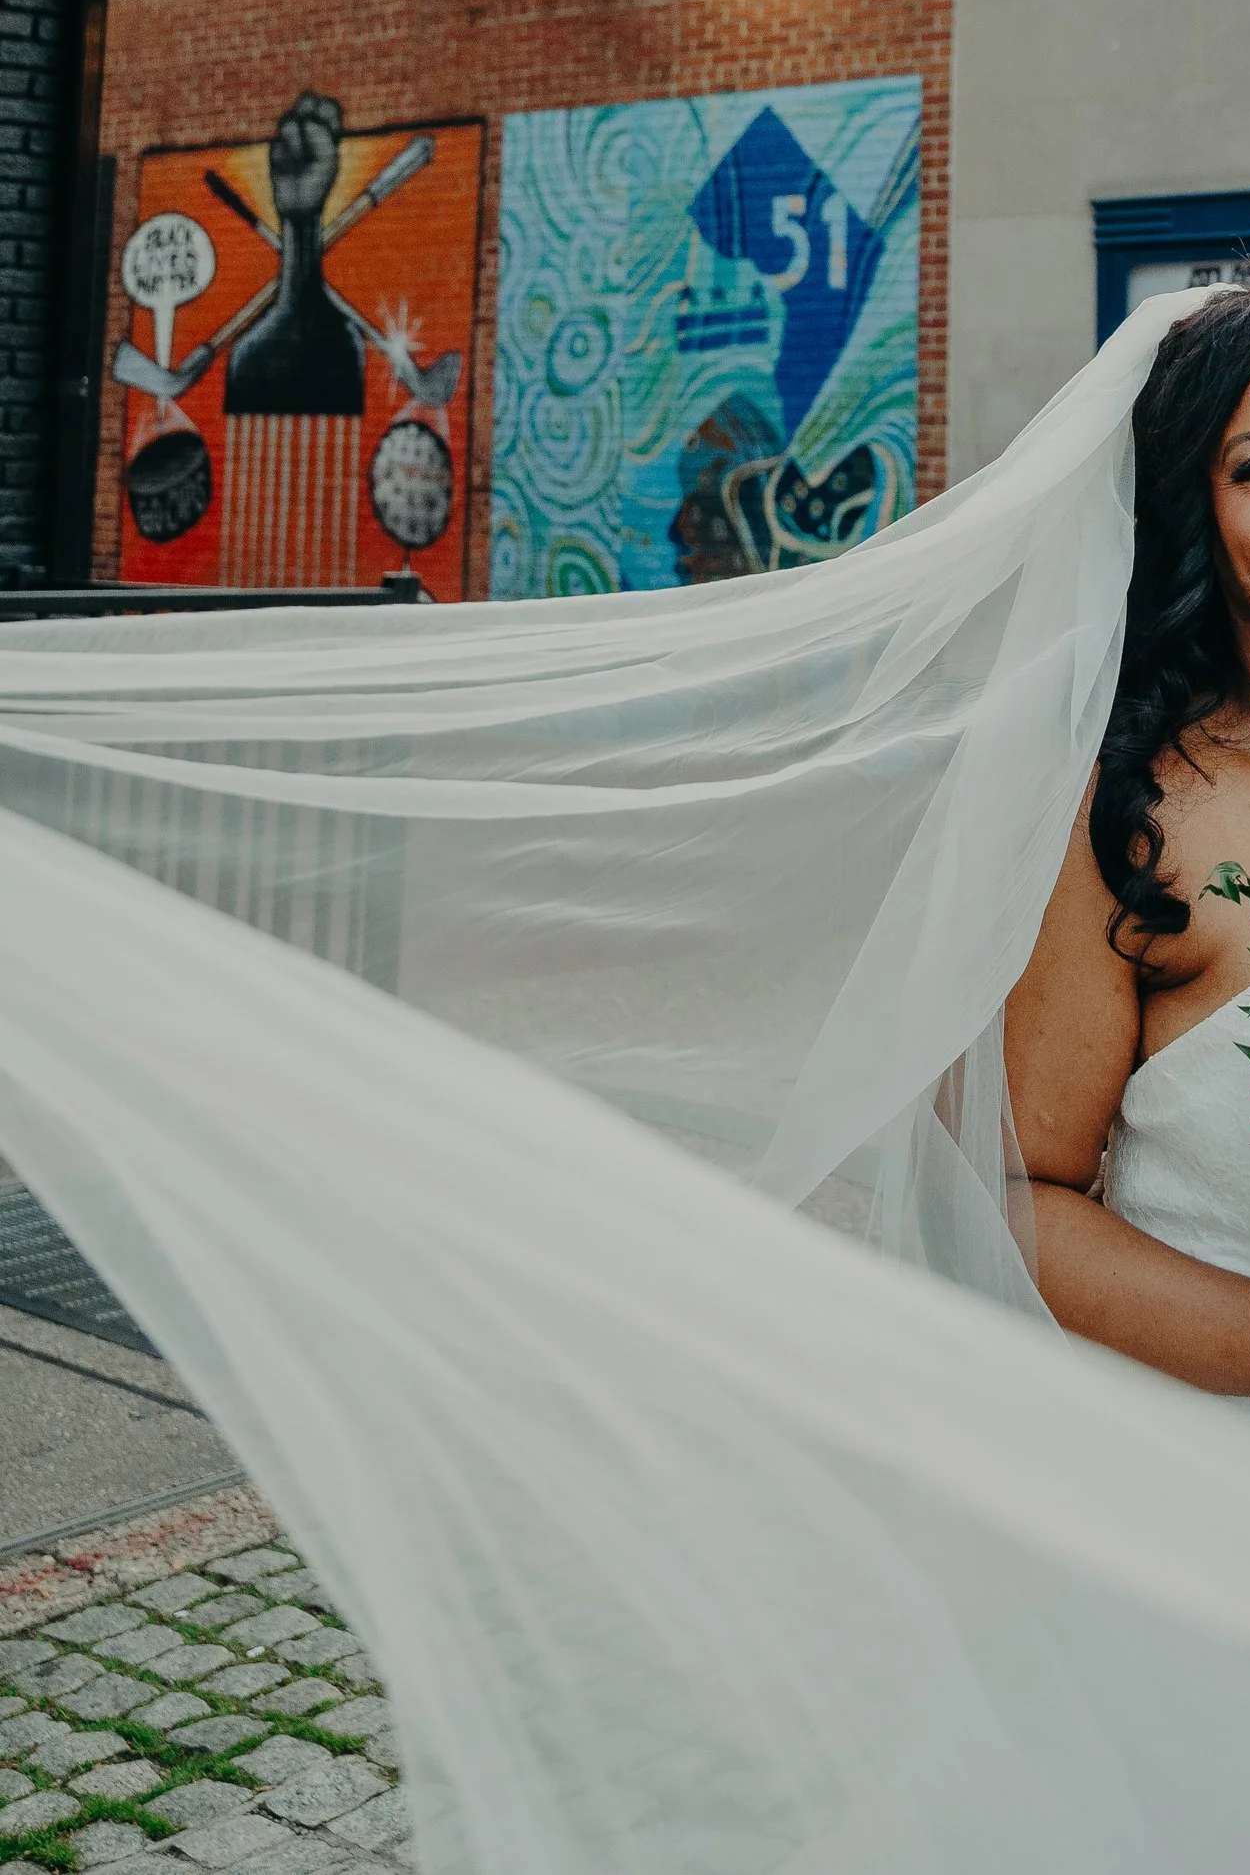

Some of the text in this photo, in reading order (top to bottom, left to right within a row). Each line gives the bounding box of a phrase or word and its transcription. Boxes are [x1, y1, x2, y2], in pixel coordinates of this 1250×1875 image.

[144, 226, 194, 251] BLACK
[763, 193, 848, 293] 51
[132, 250, 197, 275] LIVES
